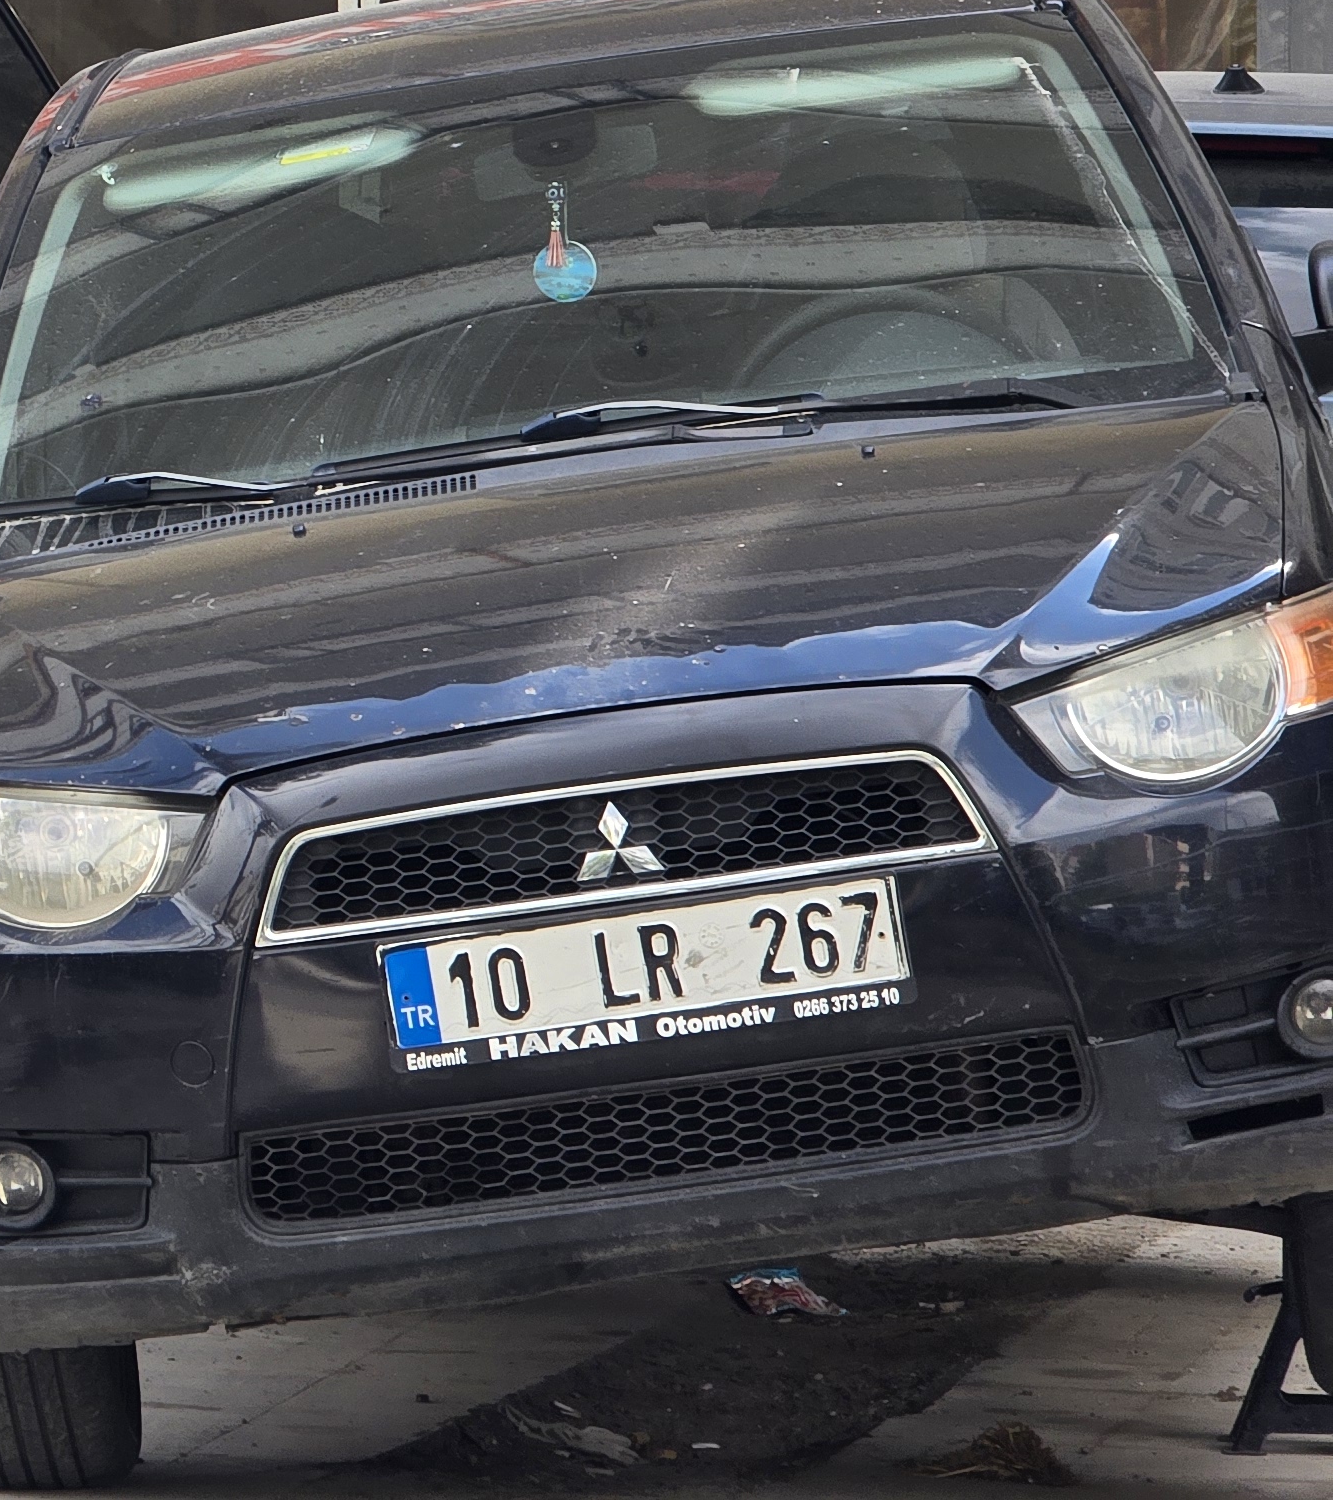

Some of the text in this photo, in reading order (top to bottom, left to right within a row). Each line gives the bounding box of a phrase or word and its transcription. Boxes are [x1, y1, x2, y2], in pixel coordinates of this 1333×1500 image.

[448, 891, 881, 1030] 10 LR 267
[400, 1004, 436, 1029] TR
[406, 987, 900, 1071] Edremit HAKAN Otomotiv 0266 373 25 10
